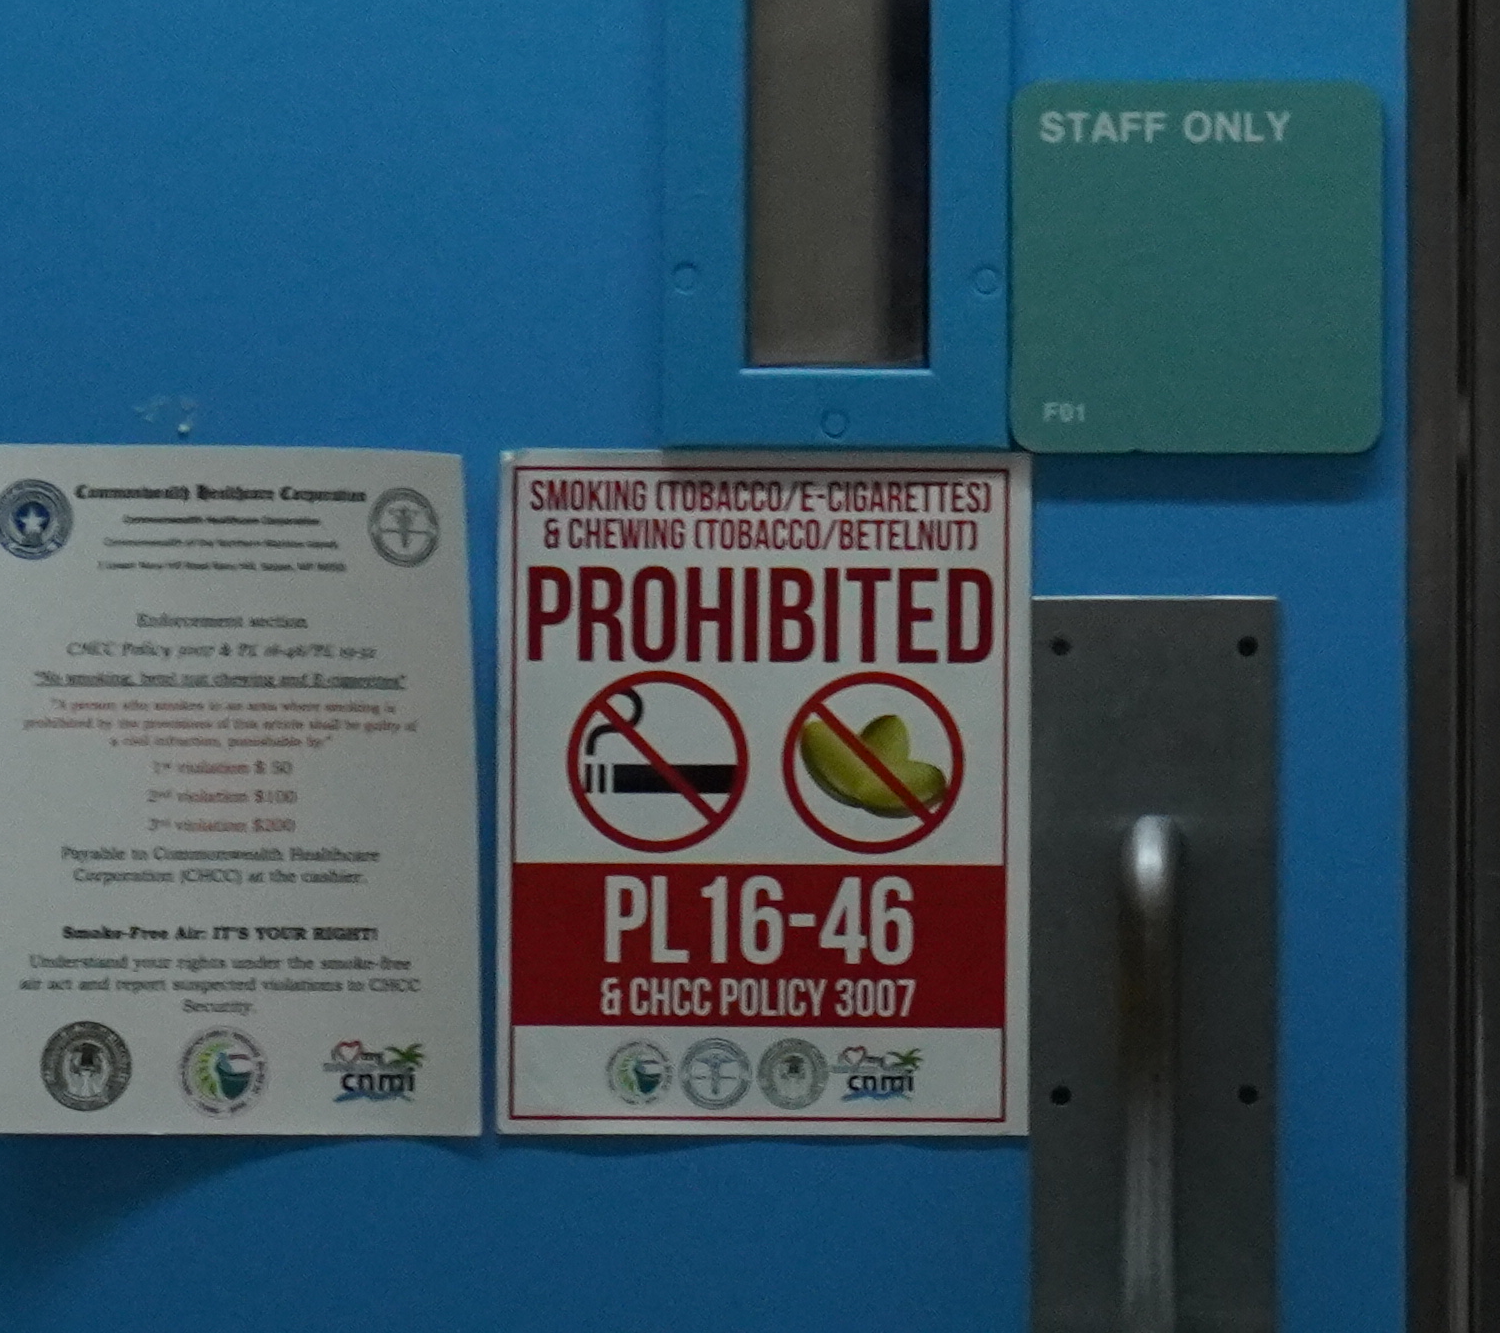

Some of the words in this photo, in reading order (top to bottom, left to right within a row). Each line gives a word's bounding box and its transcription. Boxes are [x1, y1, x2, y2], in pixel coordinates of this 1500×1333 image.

[1040, 111, 1167, 143] STAFF
[1183, 111, 1290, 143] ONLY
[530, 480, 646, 511] SMOKING
[656, 477, 990, 514] (TOBACCO/E-CIGARETTES)
[544, 518, 560, 549] &
[568, 518, 685, 549] CHEWING
[695, 519, 977, 551] (TOBACCO/BETELNUT)
[527, 565, 993, 663] PROHIBITED
[604, 875, 691, 963] PL
[700, 875, 915, 966] 16-46
[601, 977, 622, 1015] &
[630, 977, 711, 1016] CHCC
[720, 978, 827, 1016] POLICY
[835, 979, 916, 1017] 3007
